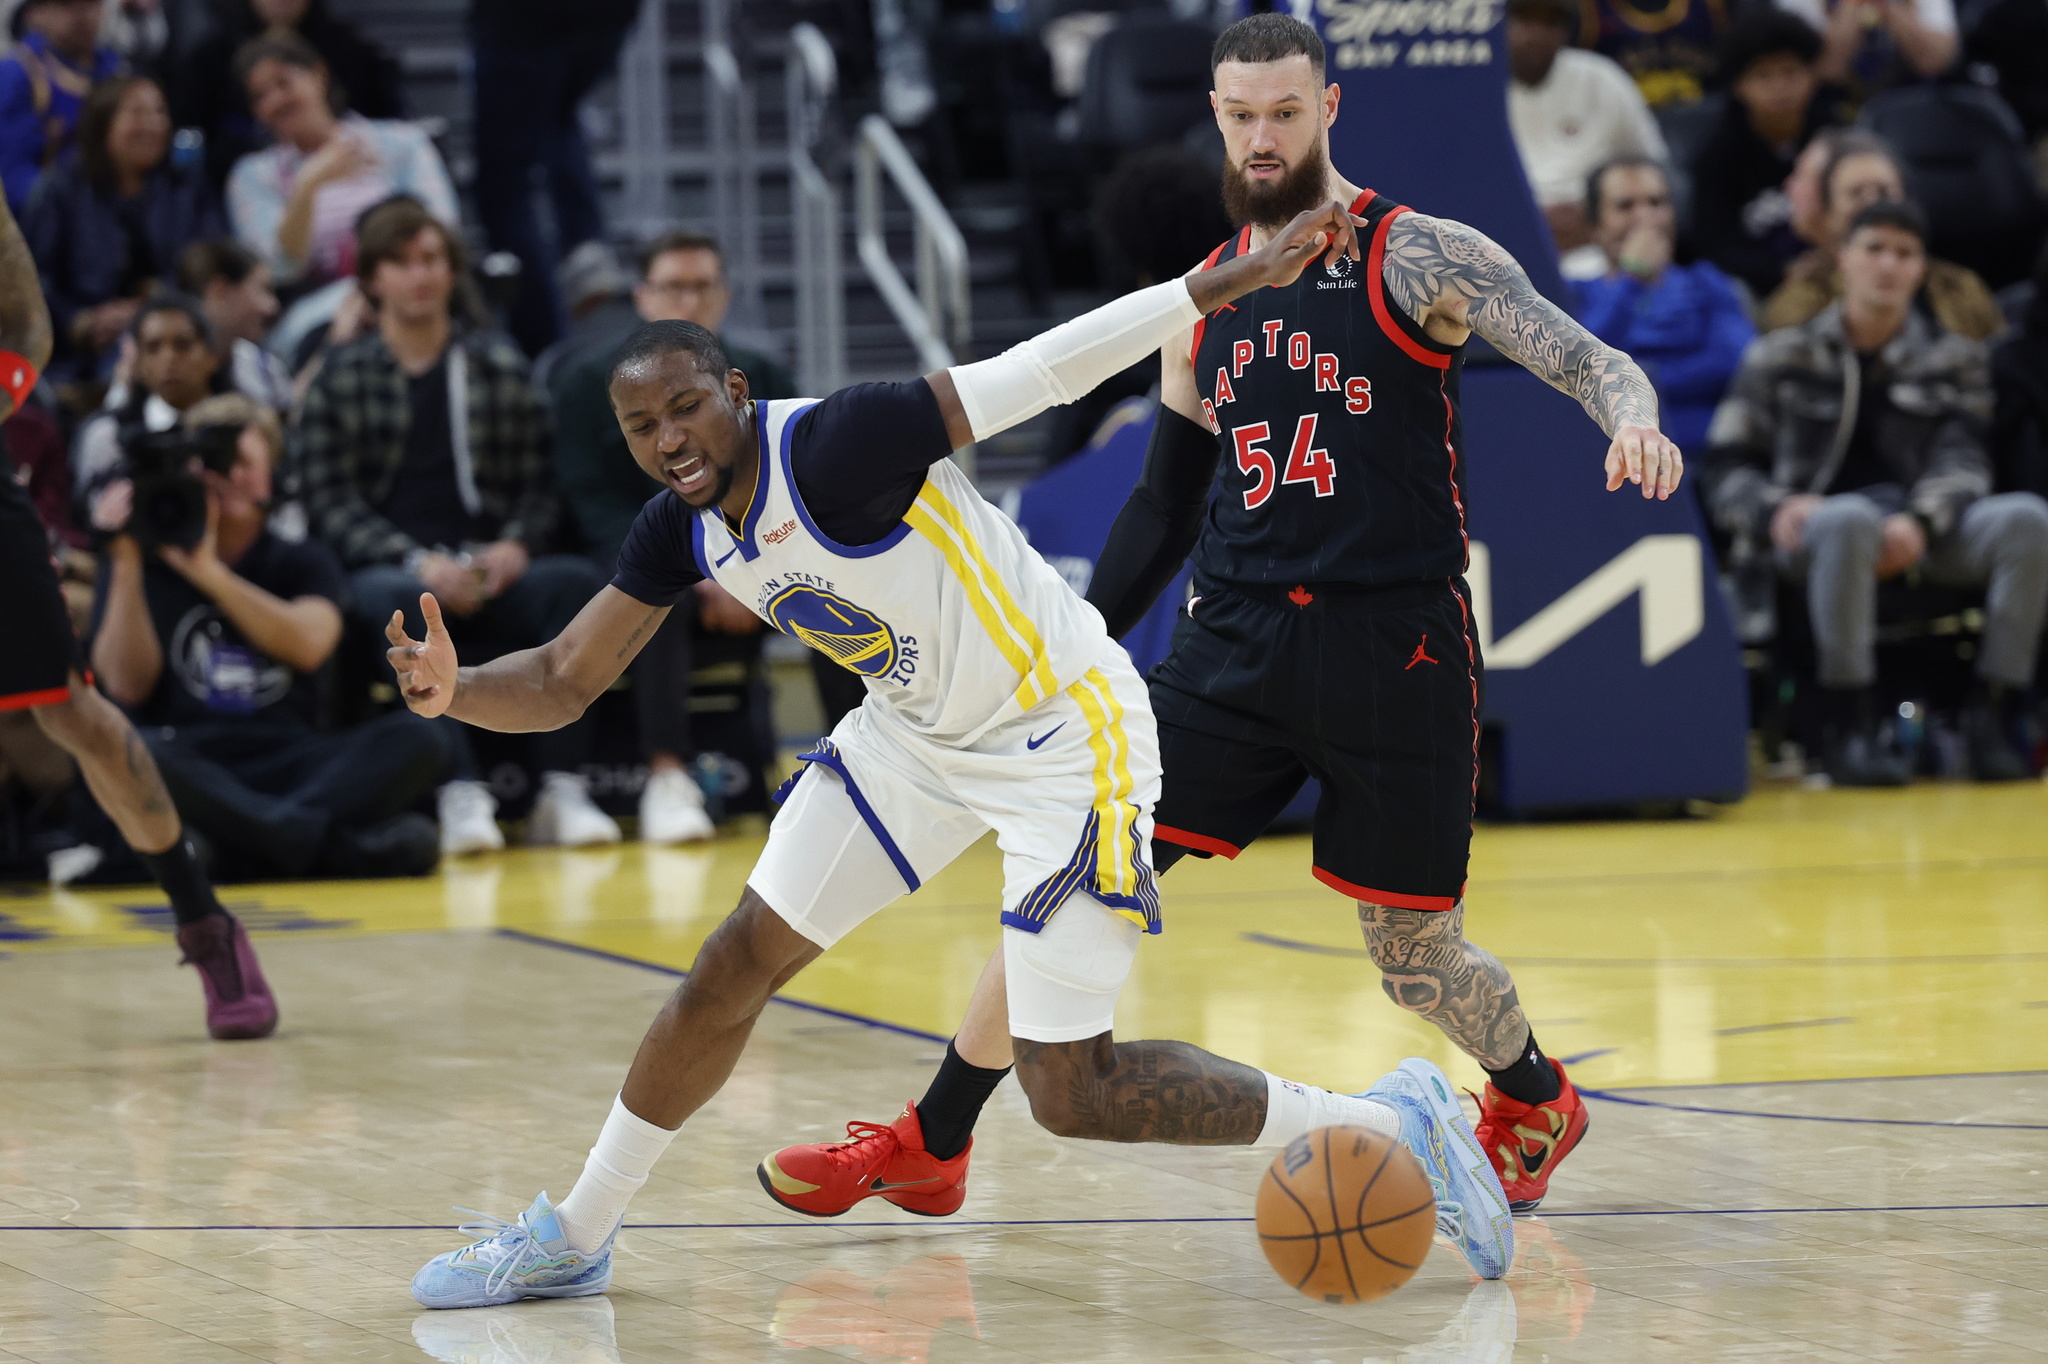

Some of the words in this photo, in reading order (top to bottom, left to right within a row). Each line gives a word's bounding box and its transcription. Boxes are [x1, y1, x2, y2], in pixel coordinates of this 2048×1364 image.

[1317, 280, 1336, 290] Sun
[1338, 278, 1357, 289] Life
[1201, 319, 1372, 436] RAPTORS
[1232, 413, 1337, 511] 54
[762, 519, 797, 546] Rakute
[783, 572, 835, 592] STATE
